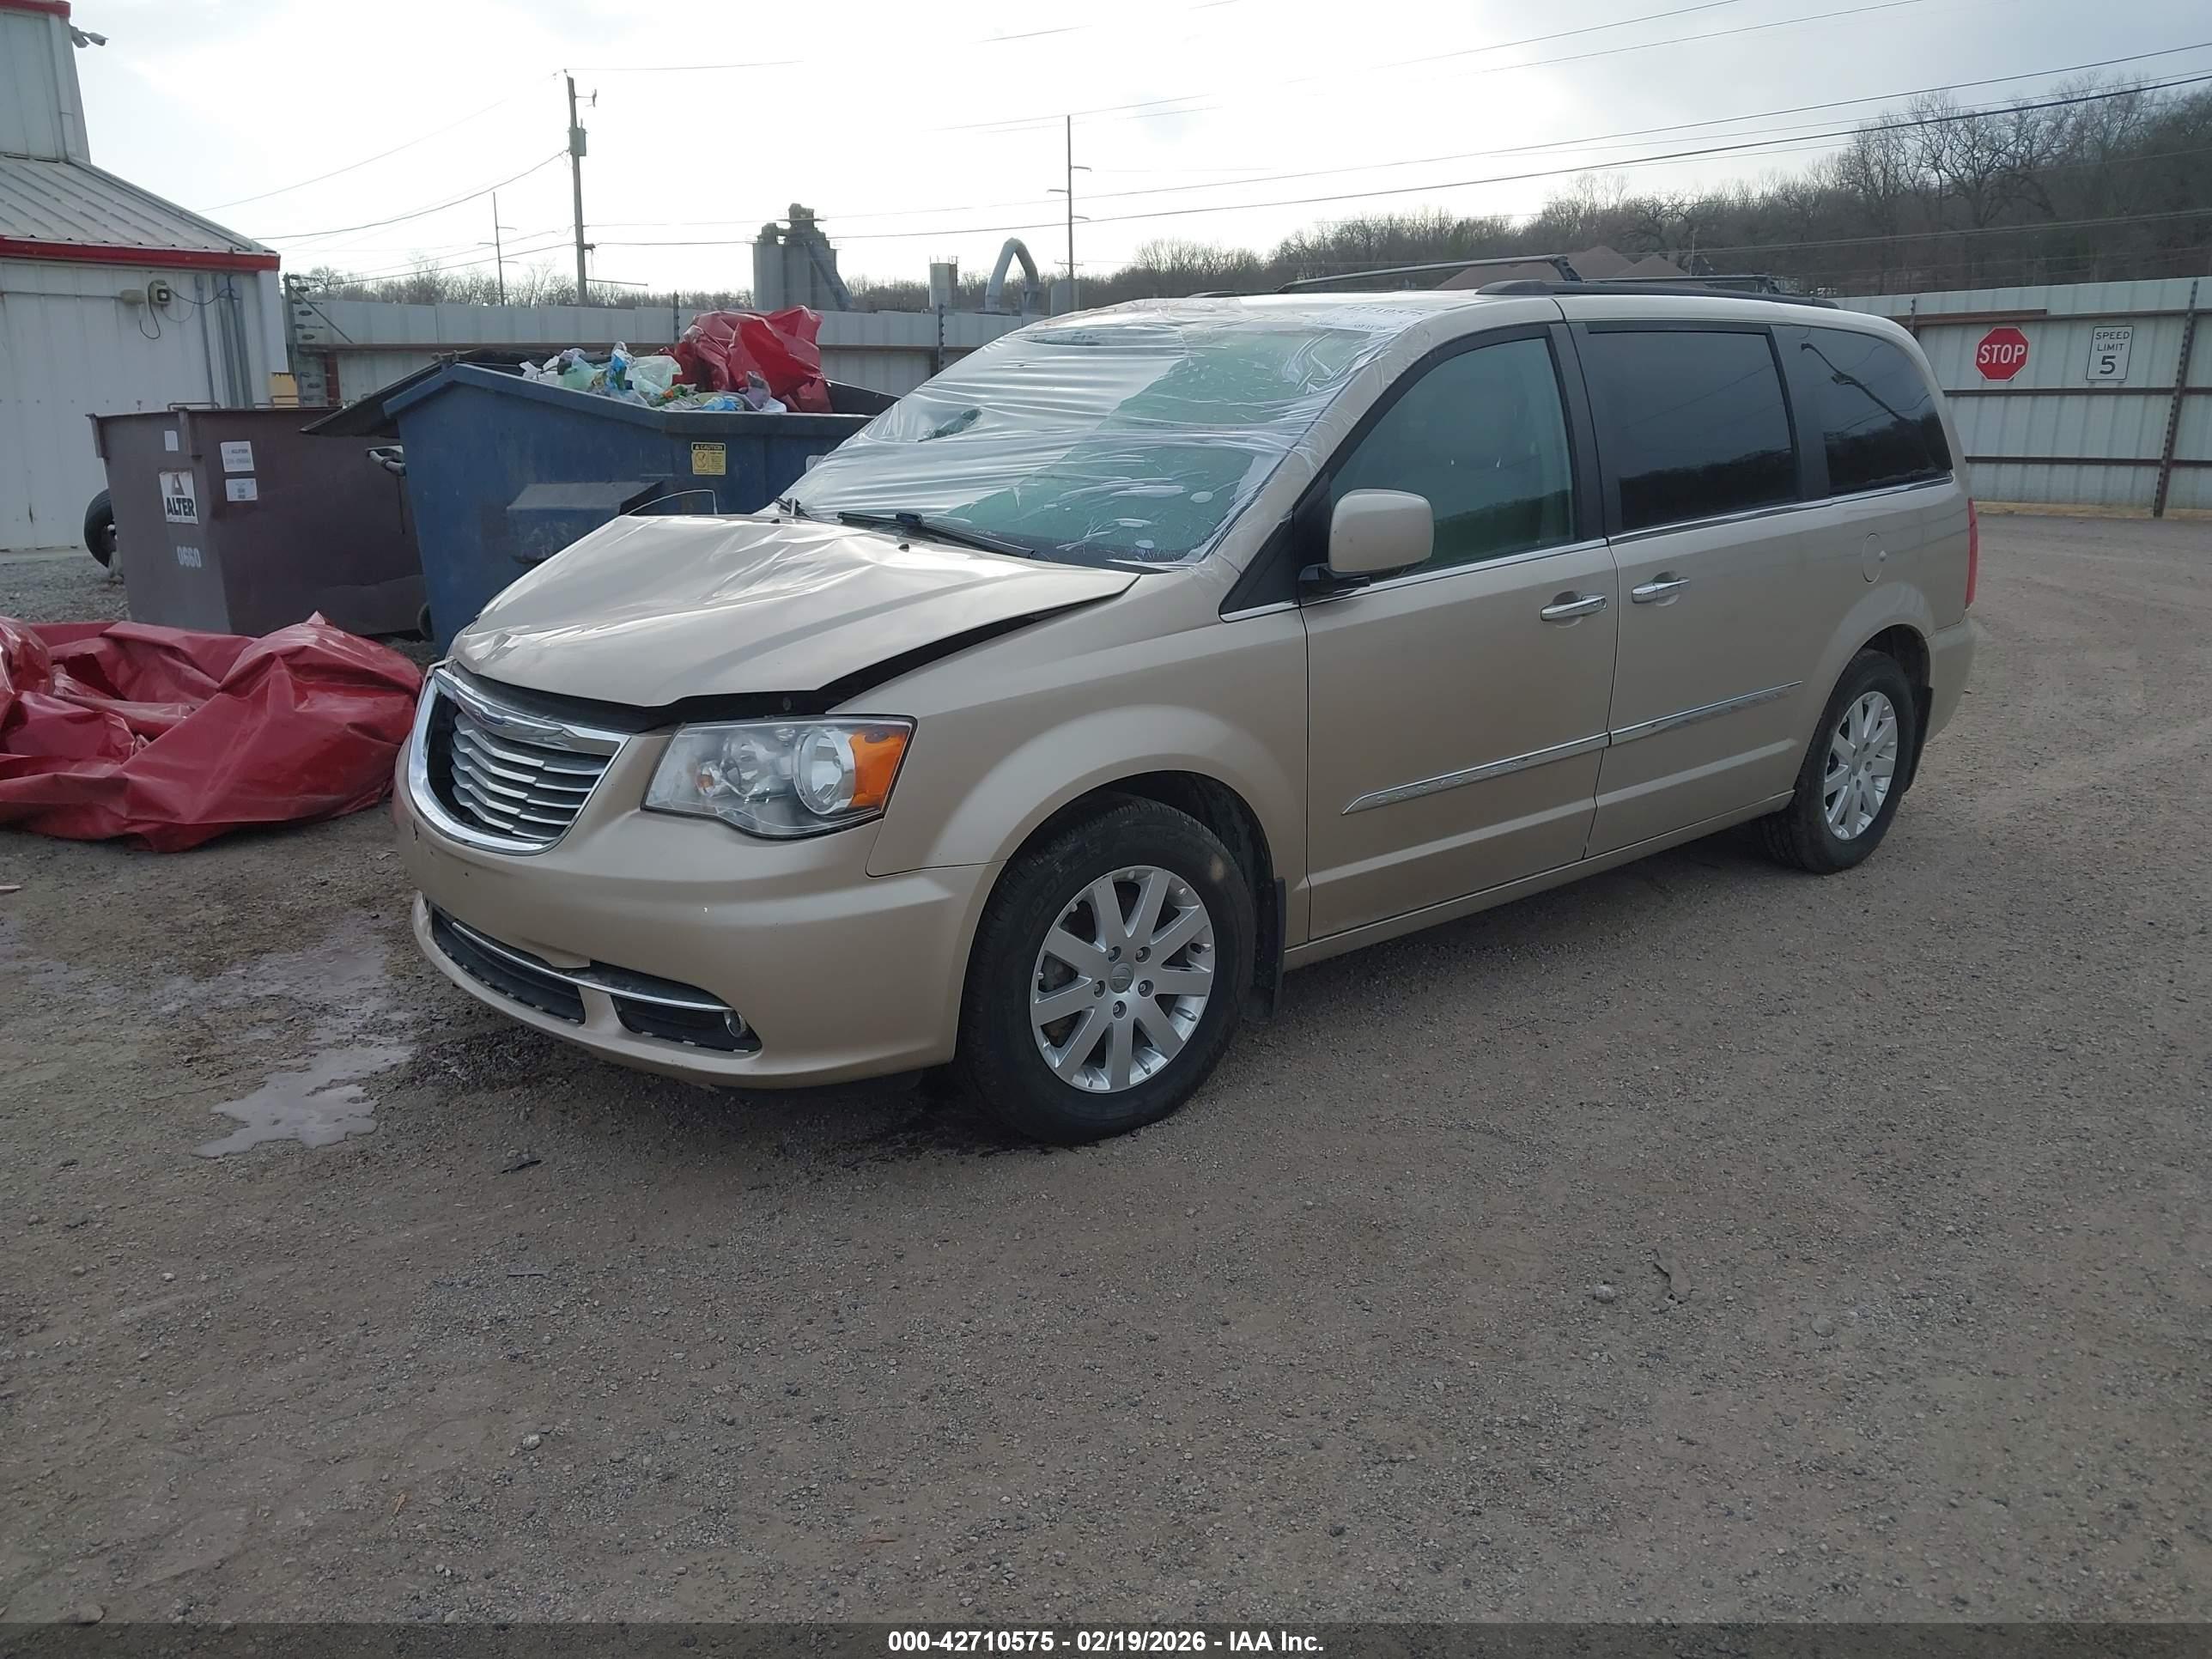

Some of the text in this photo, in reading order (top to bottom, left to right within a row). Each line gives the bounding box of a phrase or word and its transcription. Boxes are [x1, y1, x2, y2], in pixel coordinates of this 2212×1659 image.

[2095, 331, 2130, 340] SPEED
[1978, 344, 2025, 364] STOP
[2100, 356, 2116, 374] 5
[167, 497, 196, 517] ALTER
